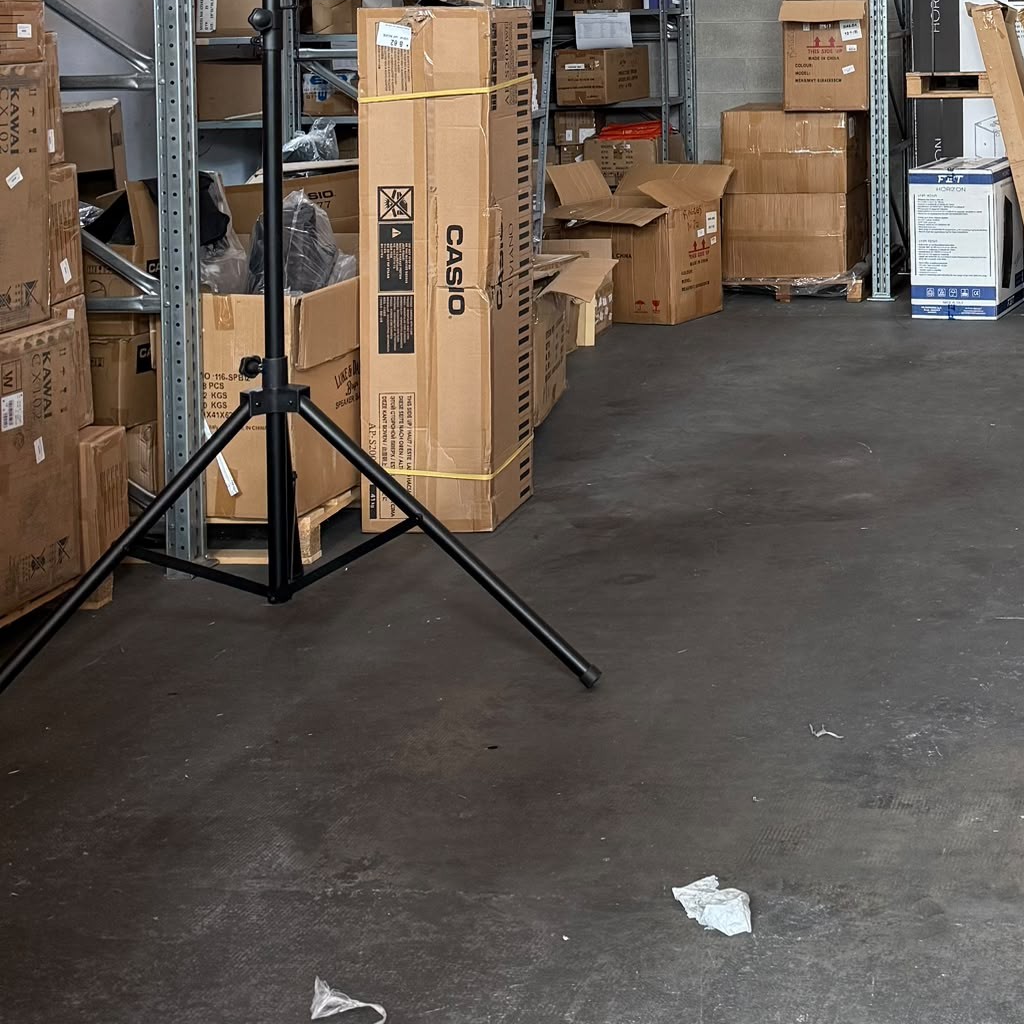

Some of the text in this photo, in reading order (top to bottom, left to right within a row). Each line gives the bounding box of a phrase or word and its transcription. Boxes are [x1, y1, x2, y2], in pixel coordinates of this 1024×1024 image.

[9, 88, 20, 155] KAWAI
[446, 224, 465, 317] CASIO
[42, 350, 51, 420] KAWAI
[209, 382, 225, 390] PCS
[211, 391, 228, 399] KGS
[211, 401, 228, 409] KGS
[335, 396, 355, 410] SPEAKER
